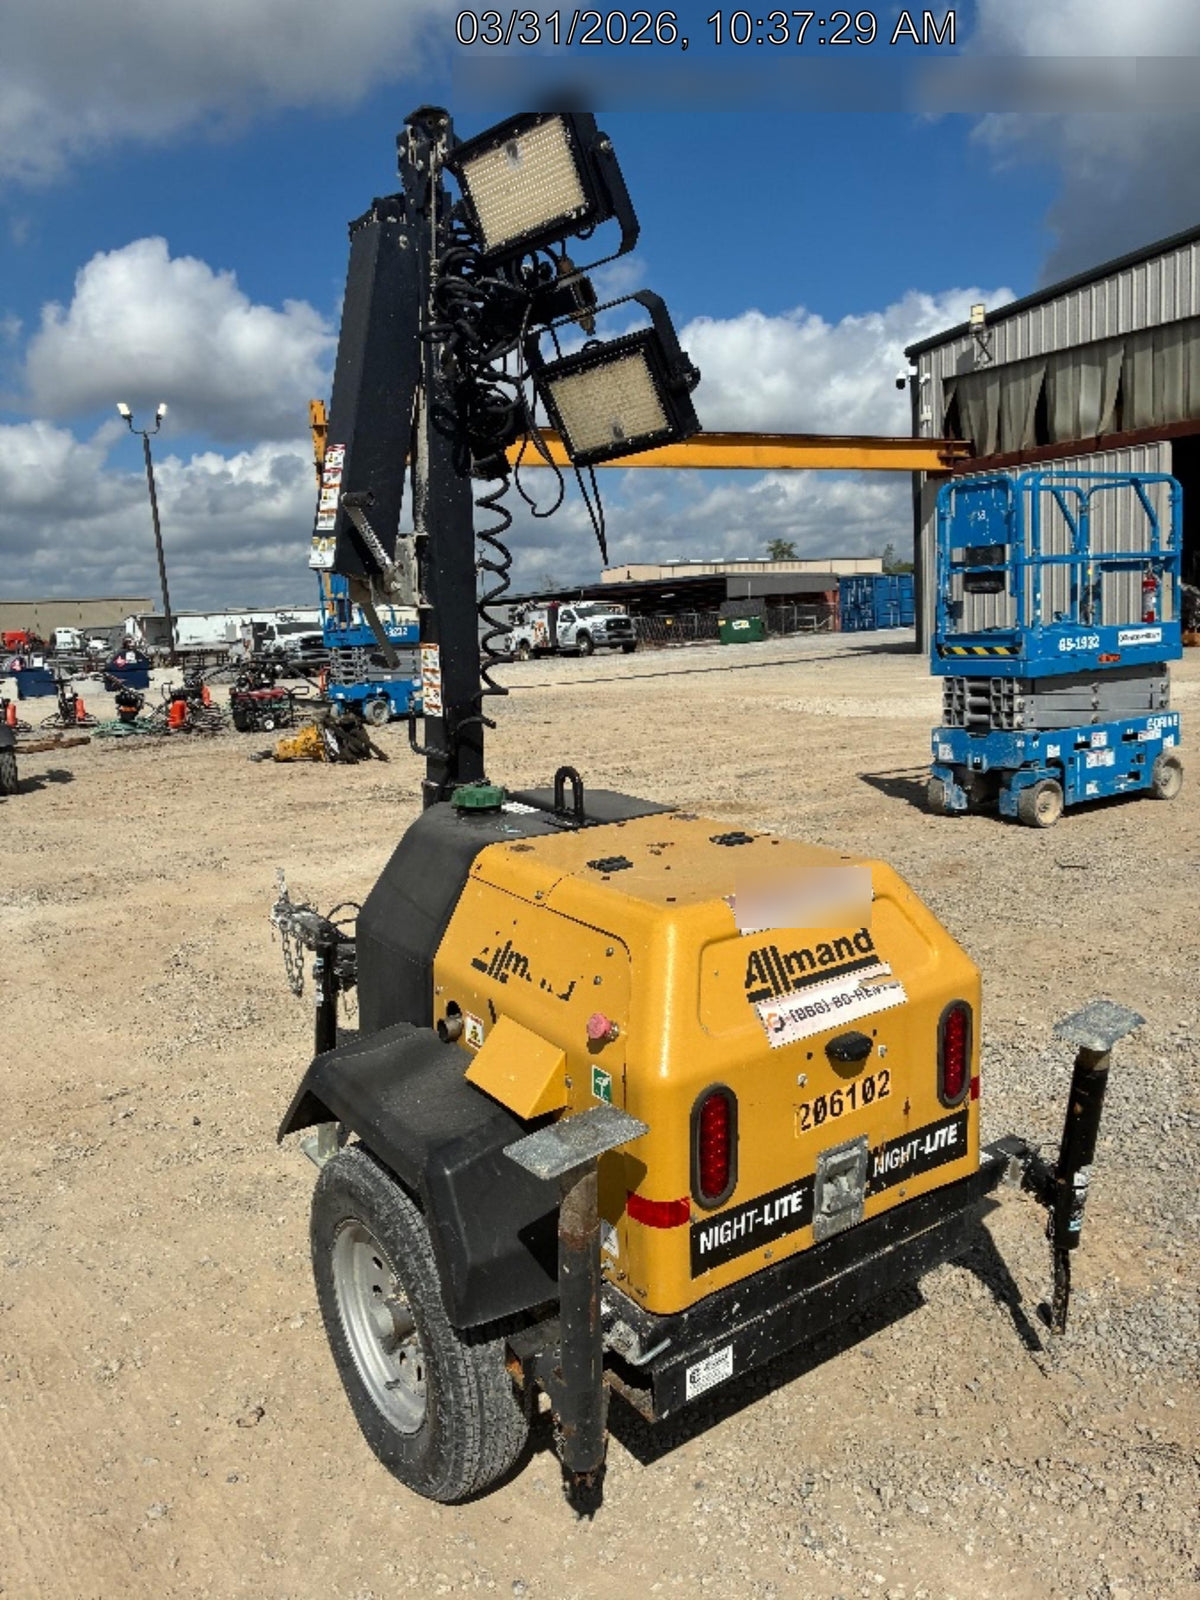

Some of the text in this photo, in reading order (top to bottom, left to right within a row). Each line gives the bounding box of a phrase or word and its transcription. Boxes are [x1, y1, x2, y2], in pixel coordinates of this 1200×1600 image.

[744, 927, 877, 999] Allmand
[799, 1069, 891, 1131] 206102
[872, 1122, 959, 1178] NIGHT-LITE
[699, 1189, 804, 1255] NIGHT-LITE
